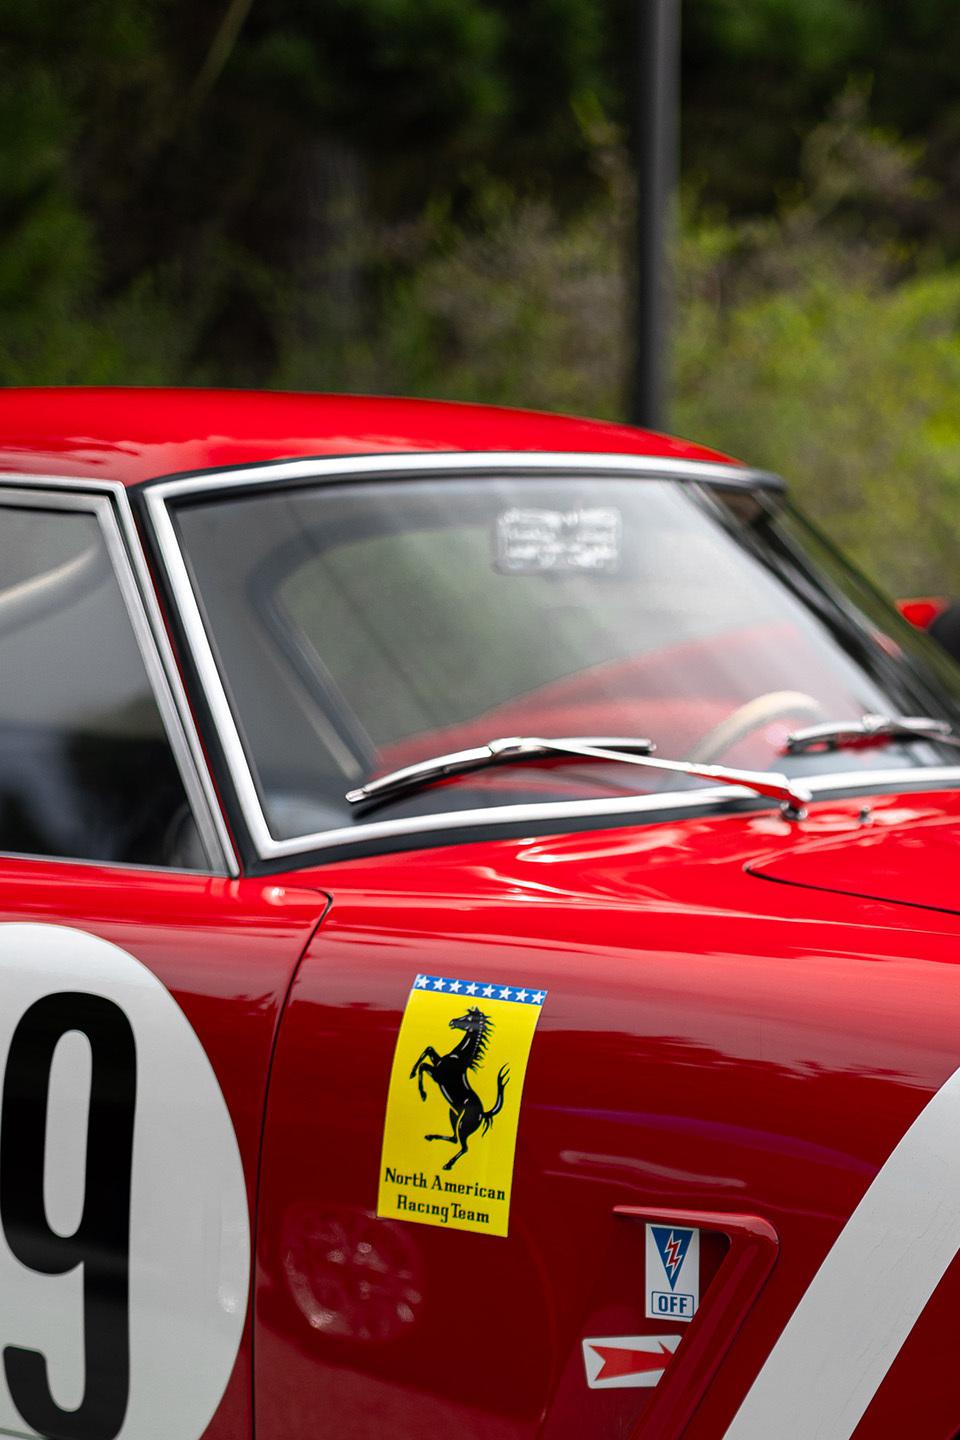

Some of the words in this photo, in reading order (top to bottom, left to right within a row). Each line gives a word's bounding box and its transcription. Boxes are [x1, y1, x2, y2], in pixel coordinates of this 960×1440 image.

[384, 1167, 428, 1190] North
[431, 1175, 506, 1201] American
[396, 1194, 449, 1224] Racing
[450, 1203, 490, 1224] Team
[658, 1296, 688, 1314] OFF
